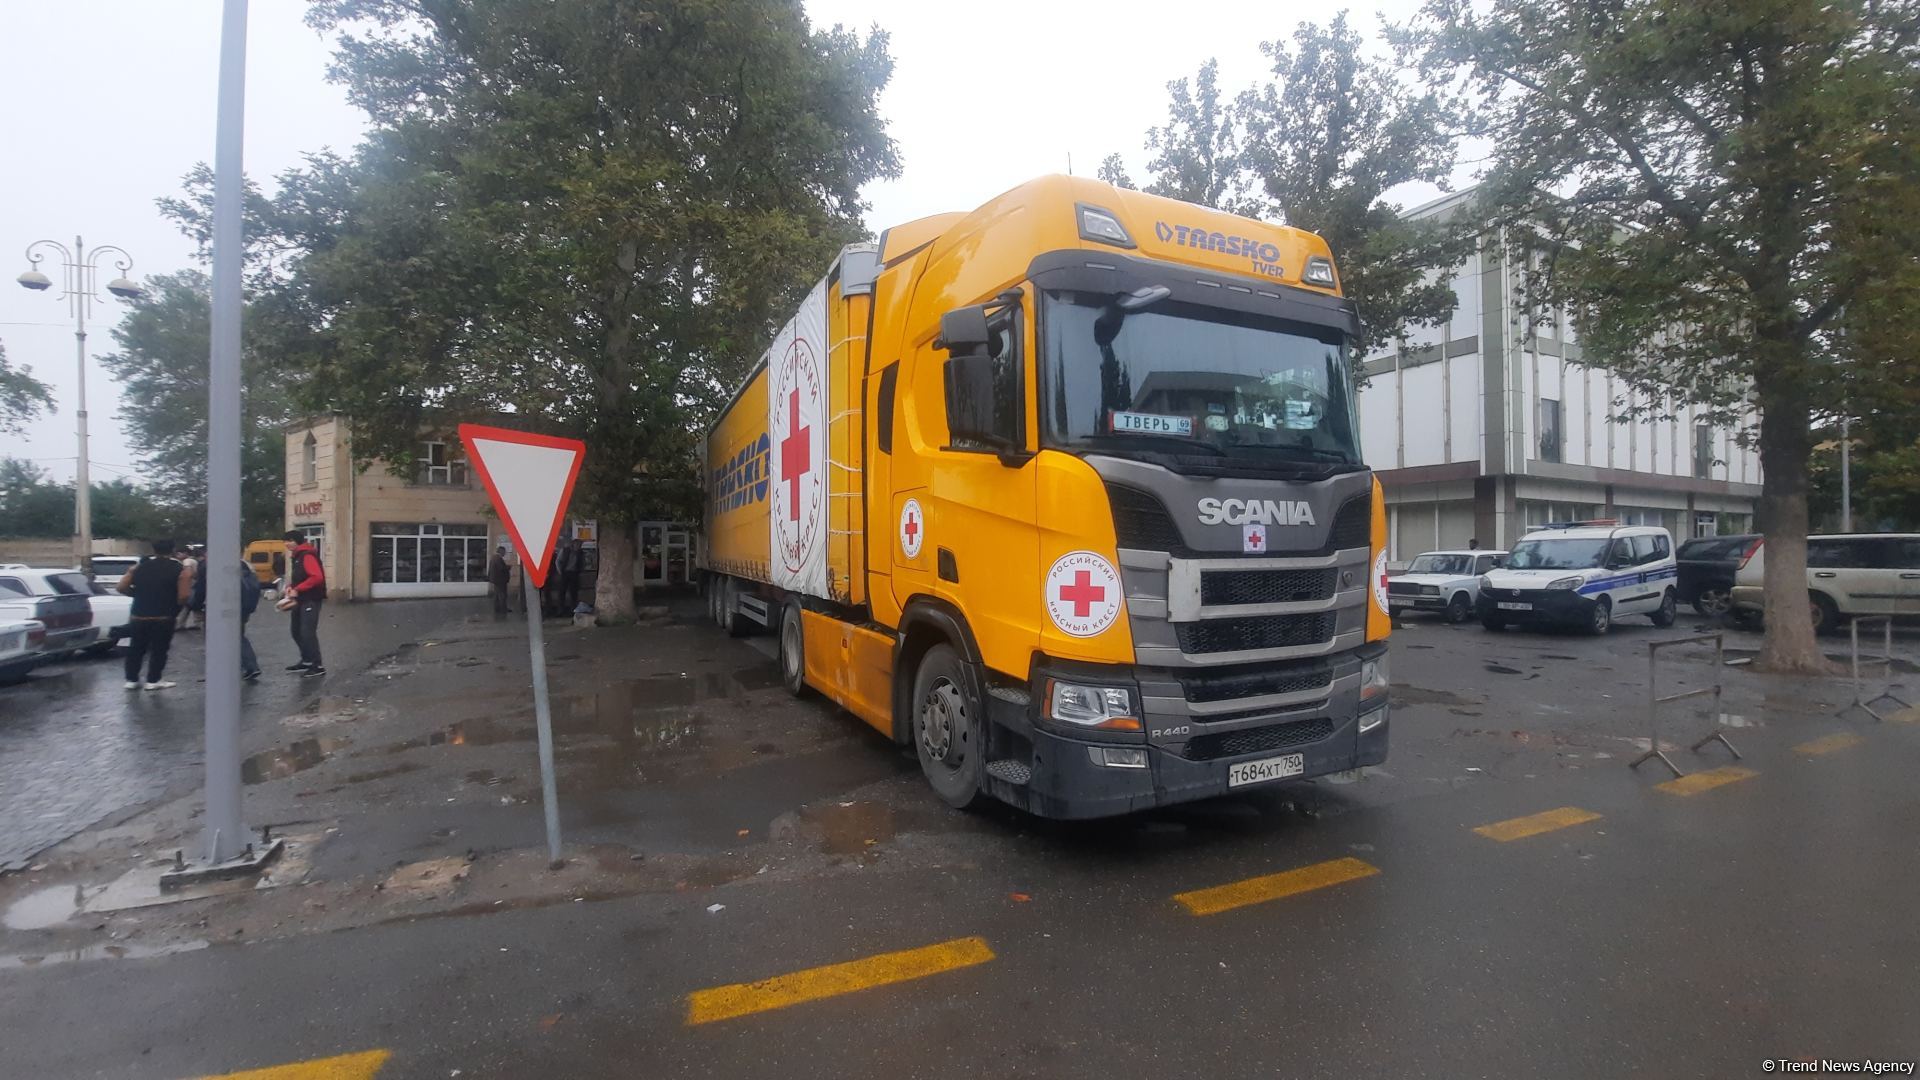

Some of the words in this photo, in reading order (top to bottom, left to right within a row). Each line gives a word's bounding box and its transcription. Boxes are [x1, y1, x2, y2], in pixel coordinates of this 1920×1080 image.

[1175, 225, 1280, 262] TRASKO
[1251, 261, 1284, 278] TVER
[1124, 415, 1170, 431] ТВЕРЬ
[1197, 497, 1316, 526] SCANIA
[1053, 556, 1115, 581] РОССИЙСКИЙ
[1050, 601, 1088, 632] КРАСНЫЙ
[1092, 603, 1116, 630] КРЕСТ
